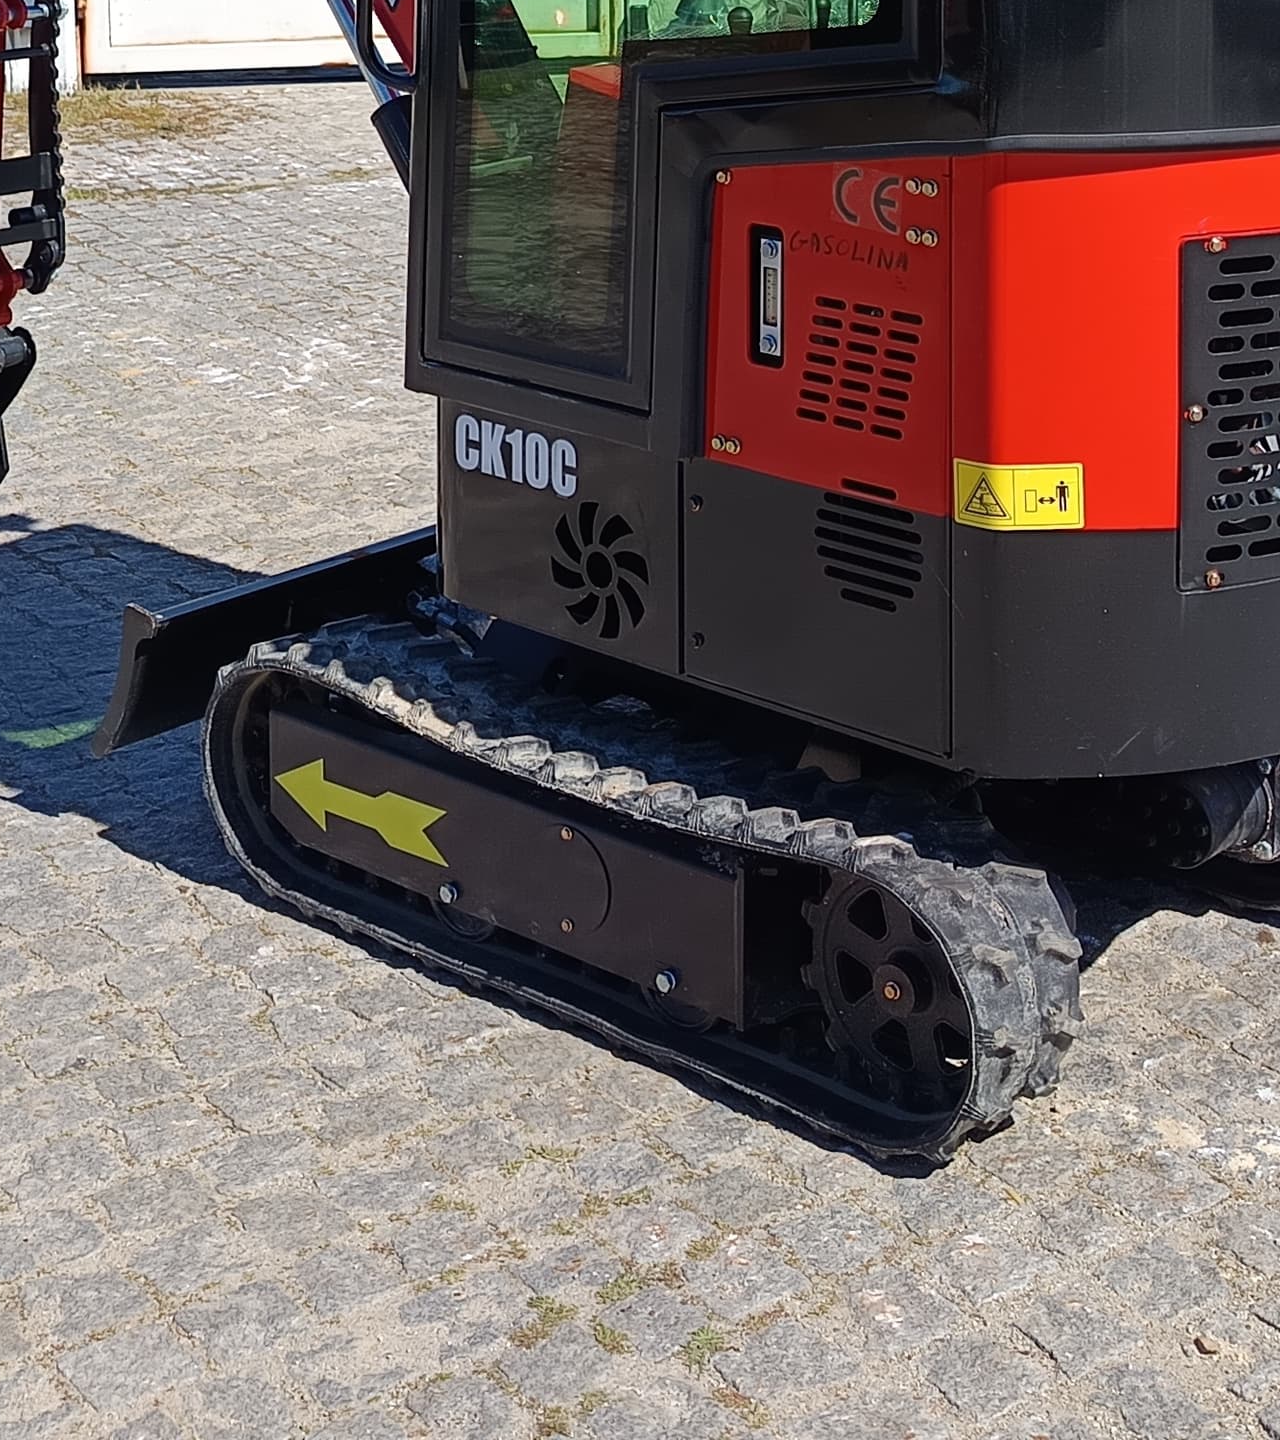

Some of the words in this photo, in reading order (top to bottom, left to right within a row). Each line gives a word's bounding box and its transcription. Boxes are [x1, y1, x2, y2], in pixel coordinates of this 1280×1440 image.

[833, 167, 902, 235] CE
[789, 230, 910, 272] GASOLINA
[454, 413, 579, 498] CK10C
